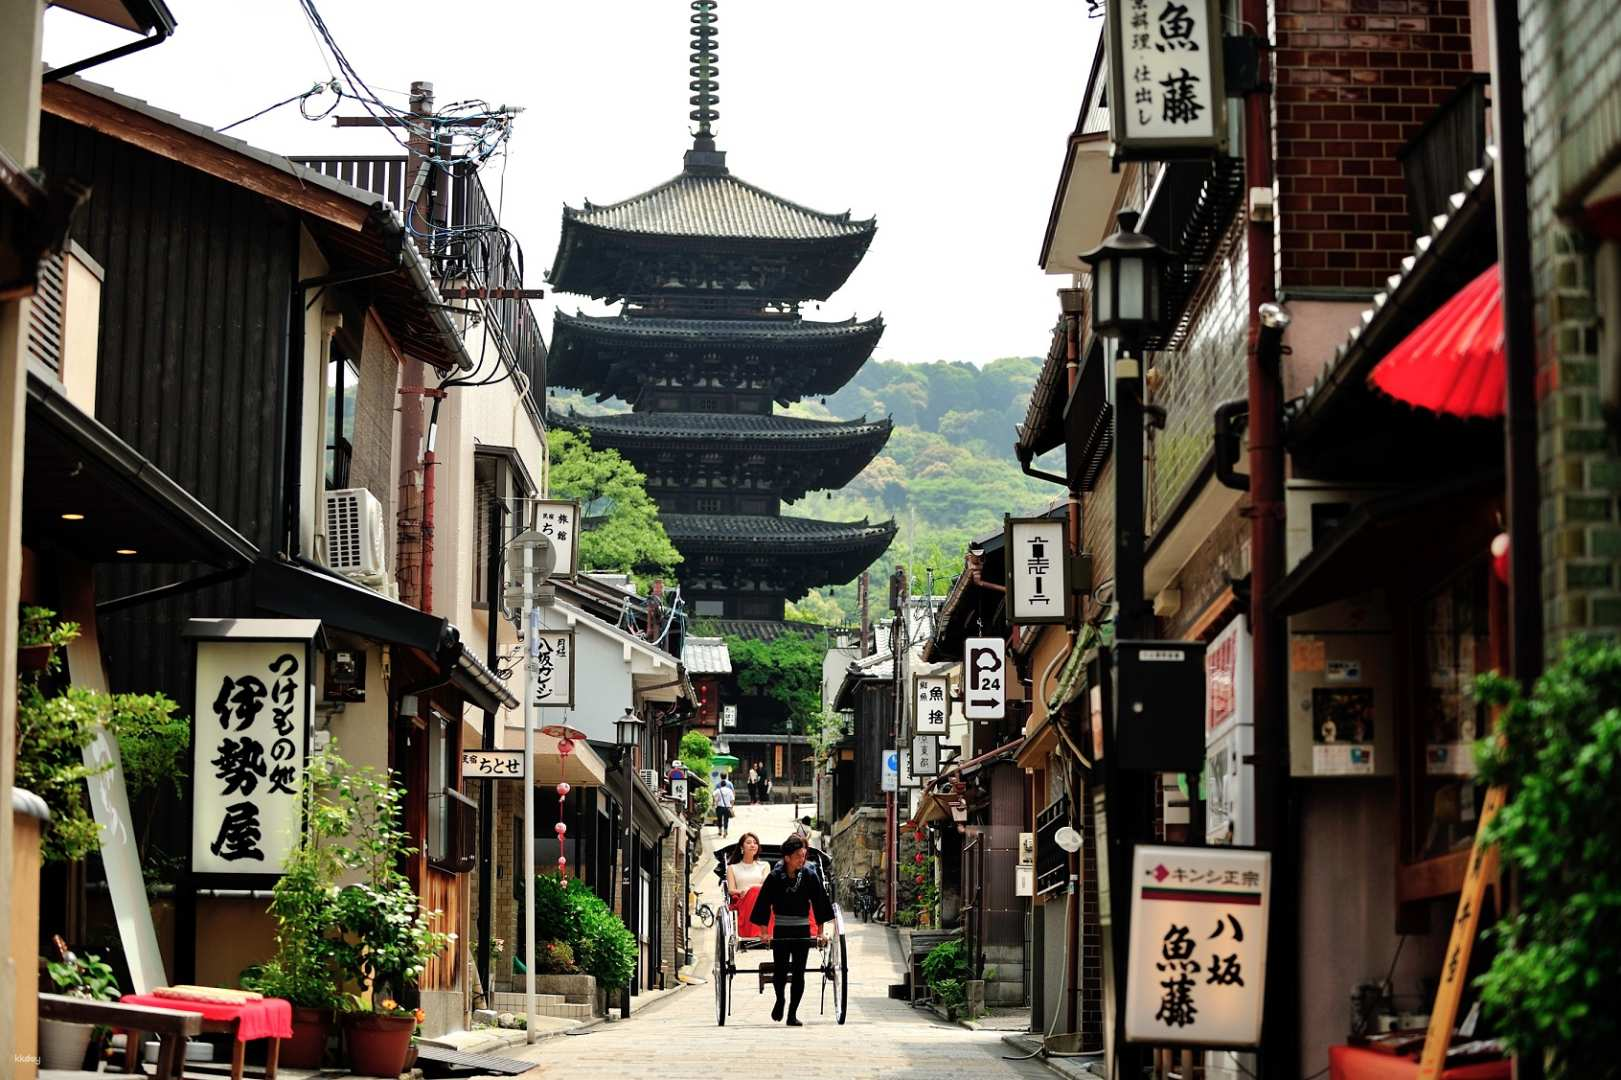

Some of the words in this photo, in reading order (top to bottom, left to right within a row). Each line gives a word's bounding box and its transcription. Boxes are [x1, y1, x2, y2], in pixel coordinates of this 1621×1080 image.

[1155, 1, 1205, 124] 魚藤
[536, 637, 554, 699] 八坂ガレージ
[981, 677, 1001, 691] 24
[267, 653, 299, 795] つけもの処
[210, 675, 268, 861] 伊勢屋
[479, 757, 521, 775] ちとせ
[1171, 866, 1261, 888] キンシ正宗
[1155, 923, 1202, 1029] 魚藤
[1205, 913, 1246, 988] 八坂
